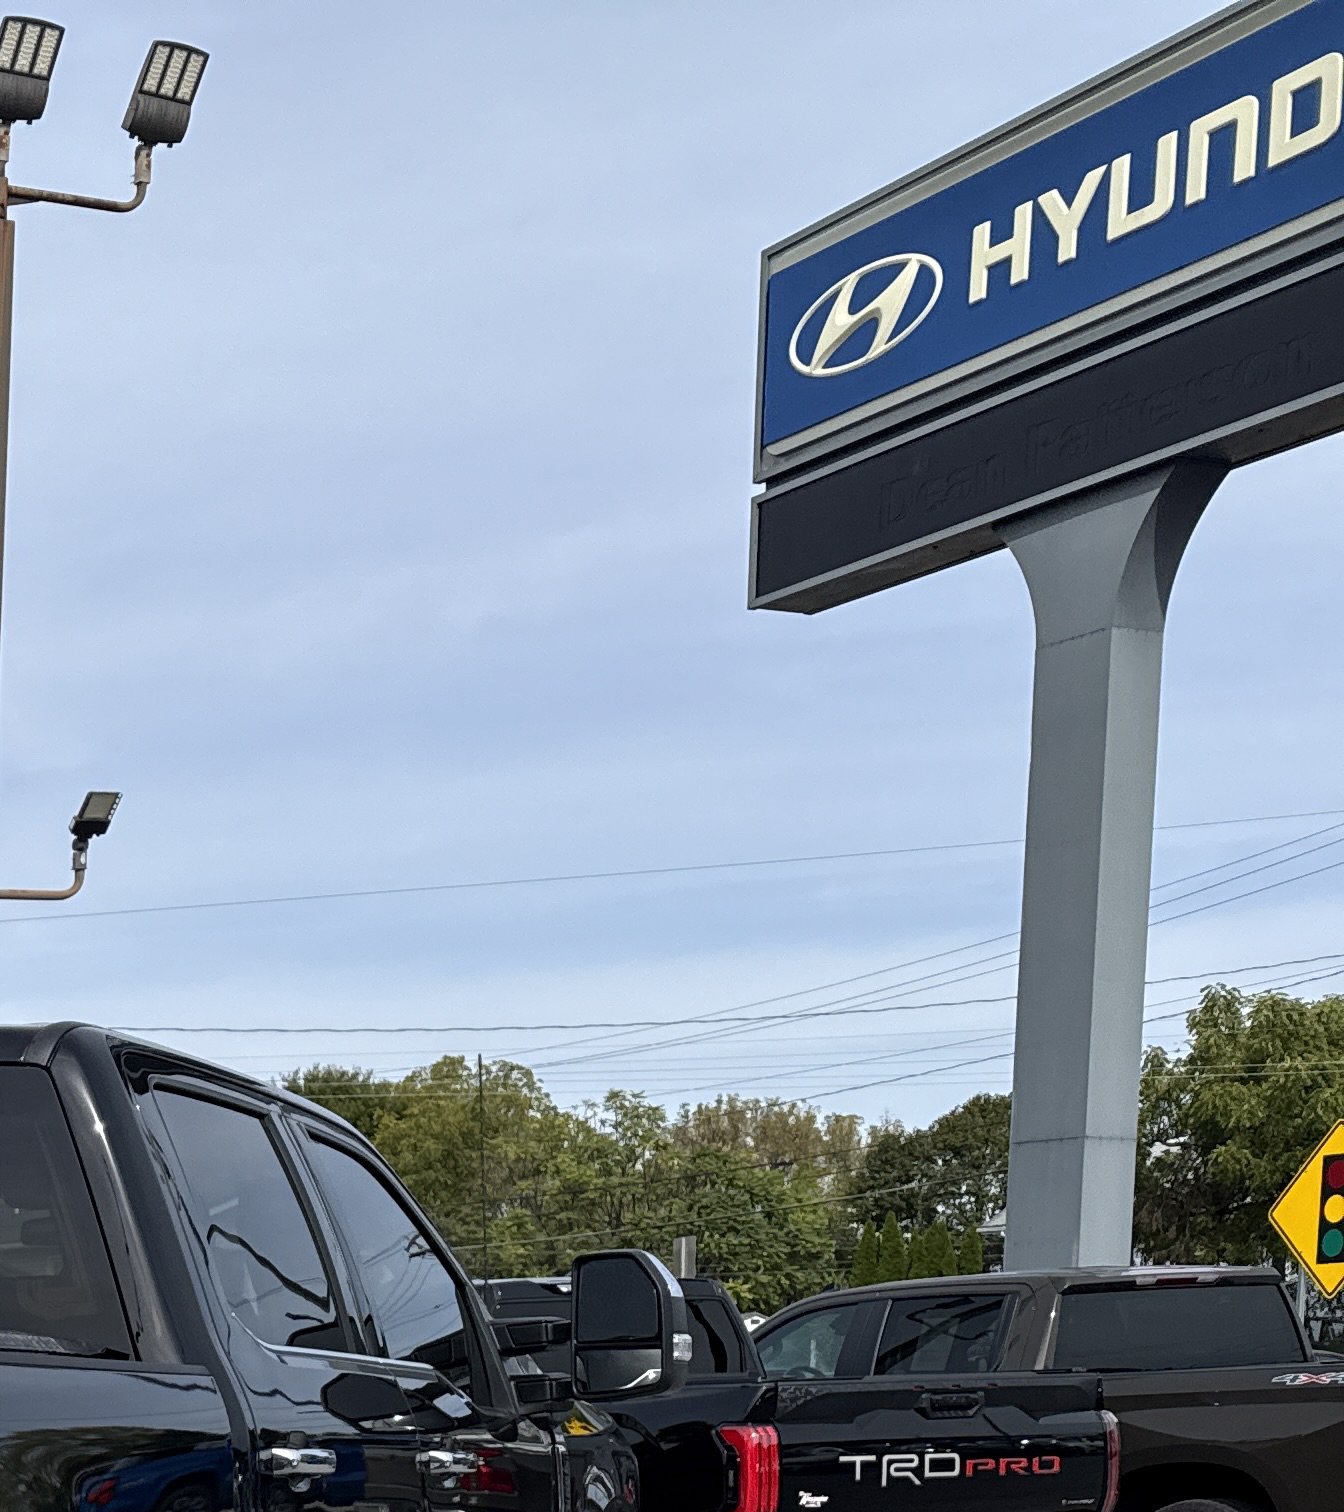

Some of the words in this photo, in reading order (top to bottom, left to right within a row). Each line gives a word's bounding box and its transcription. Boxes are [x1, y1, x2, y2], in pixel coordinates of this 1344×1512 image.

[967, 51, 1344, 305] HYUND
[839, 1453, 960, 1488] TRD
[965, 1456, 1061, 1478] PRO
